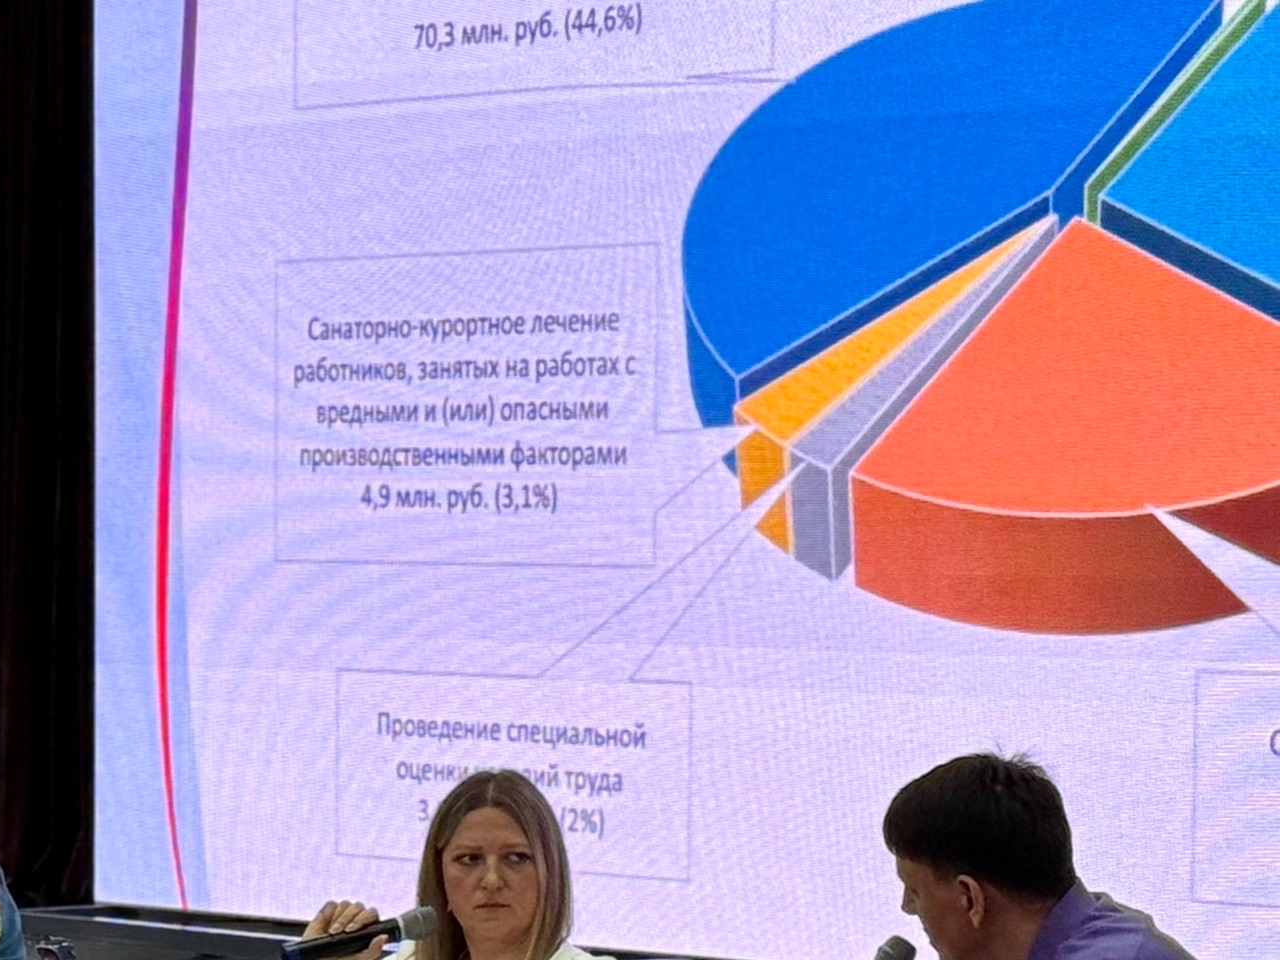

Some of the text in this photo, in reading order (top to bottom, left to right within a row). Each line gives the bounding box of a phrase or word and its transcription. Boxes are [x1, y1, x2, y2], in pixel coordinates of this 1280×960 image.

[414, 3, 642, 51] 70,3 млн. руб. (44,6%)
[308, 311, 620, 343] Санаторно-курортное лечение
[293, 351, 636, 388] работников, занятых на работах с
[316, 396, 608, 428] вредными и (или) опасными
[299, 440, 627, 471] производственными факторами
[360, 482, 558, 513] 4,9 млн. руб. (3,1%)
[377, 711, 647, 749] Проведение специальной
[565, 770, 623, 795] труда
